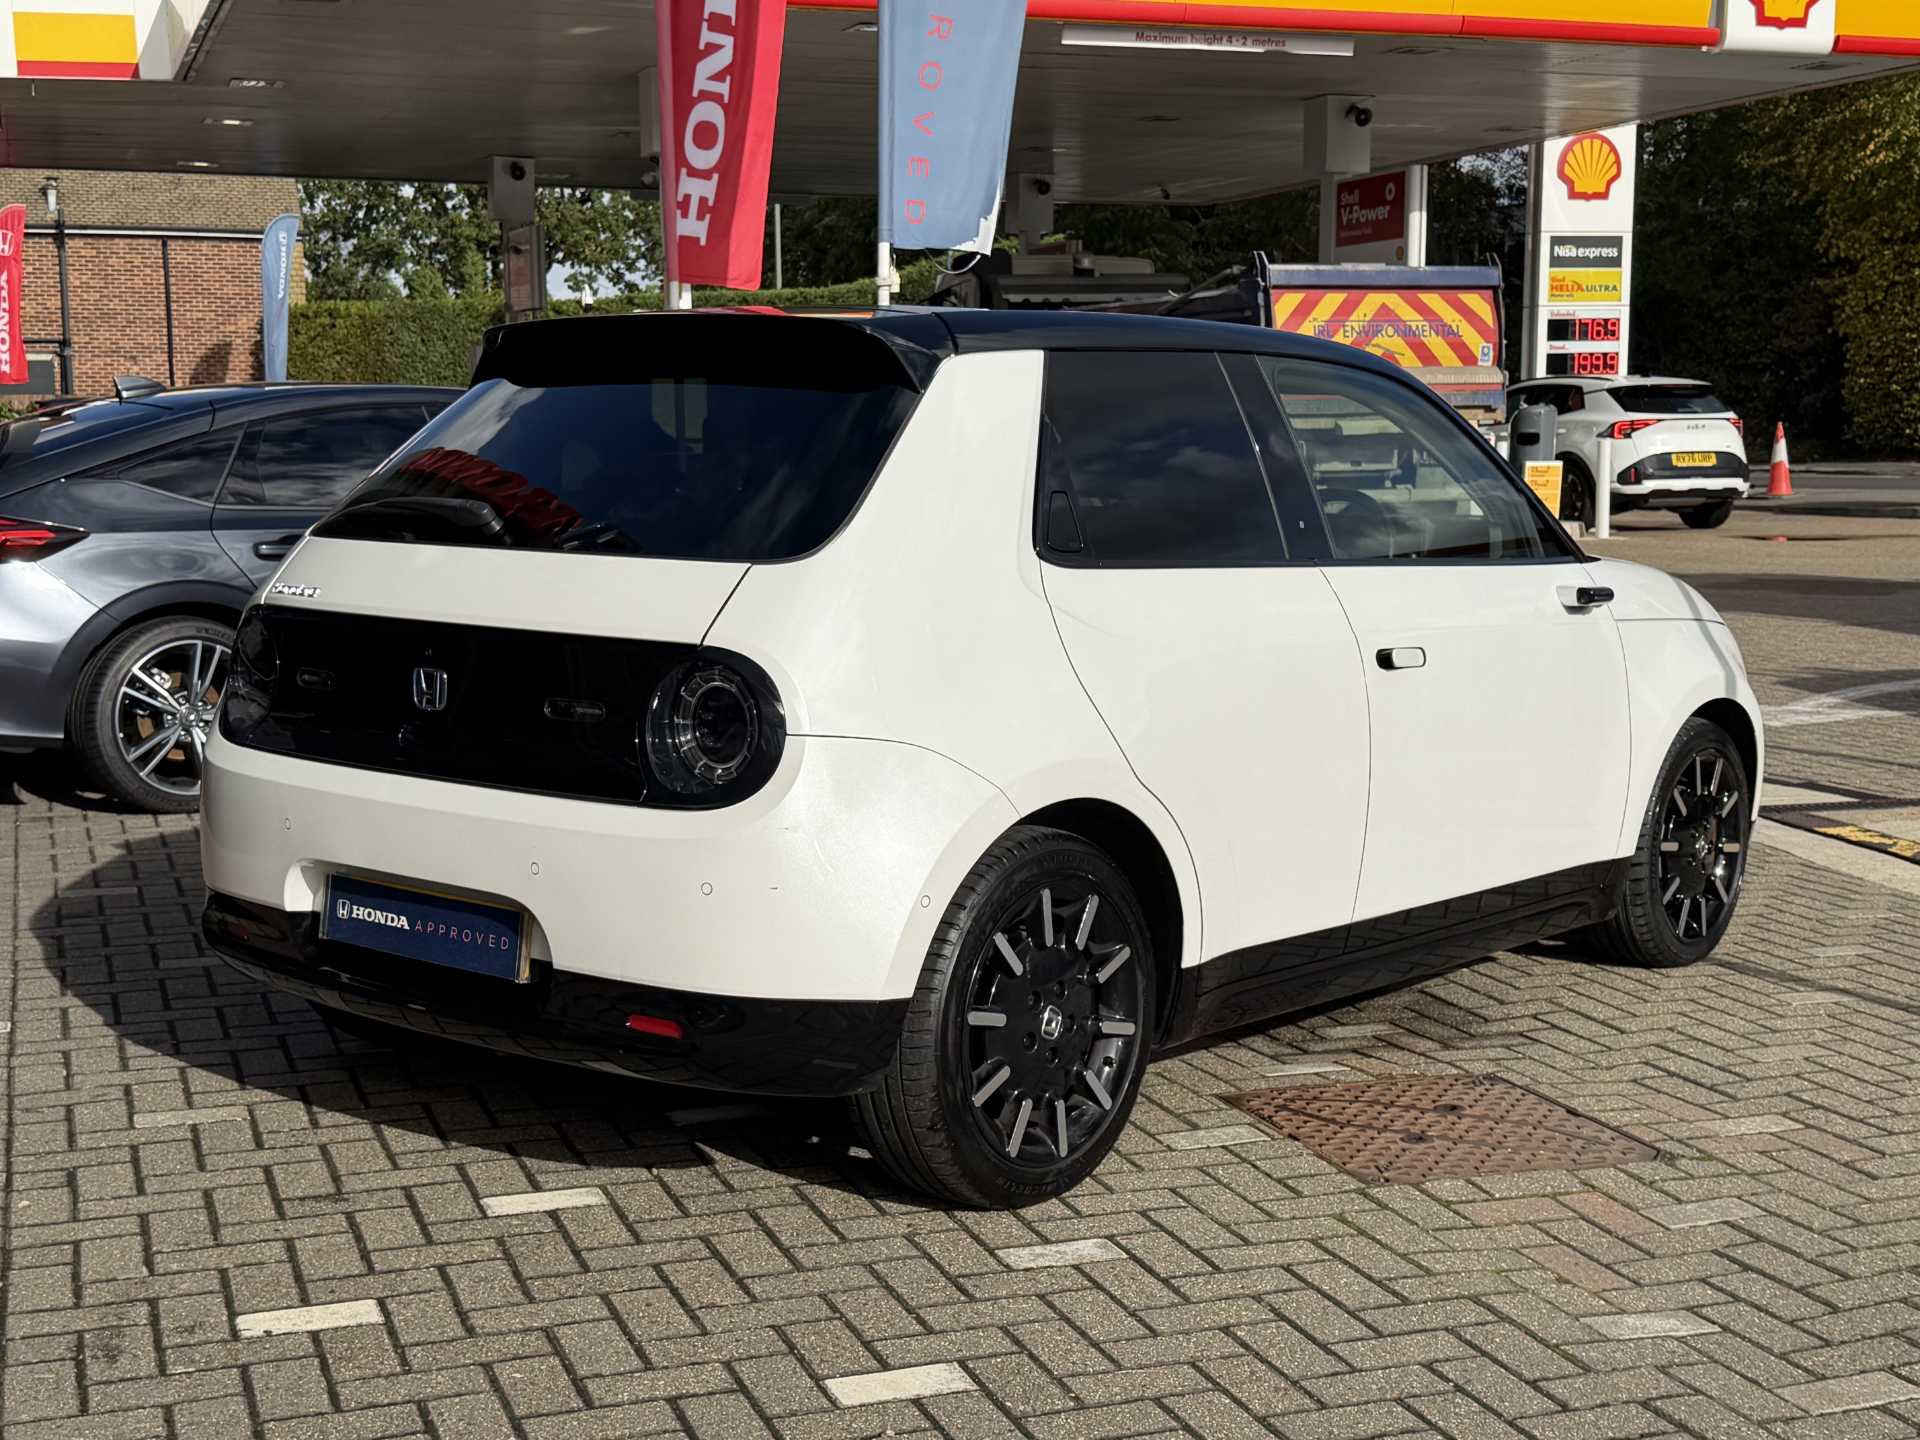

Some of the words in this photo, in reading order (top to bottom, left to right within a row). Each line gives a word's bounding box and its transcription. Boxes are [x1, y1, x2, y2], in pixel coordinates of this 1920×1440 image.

[1135, 31, 1185, 44] Maximum
[1190, 32, 1223, 46] height
[1252, 37, 1287, 48] metres
[904, 0, 954, 225] ROVED
[1341, 205, 1392, 226] V-Power
[1553, 245, 1577, 257] Nisa
[1577, 247, 1619, 259] express
[1585, 284, 1619, 293] ULTRA
[1343, 323, 1464, 339] ENVIRONMENTAL
[1575, 318, 1619, 340] 176.9
[1574, 352, 1618, 374] 199.9
[351, 905, 410, 930] HONDA
[415, 919, 509, 950] APPROVED
